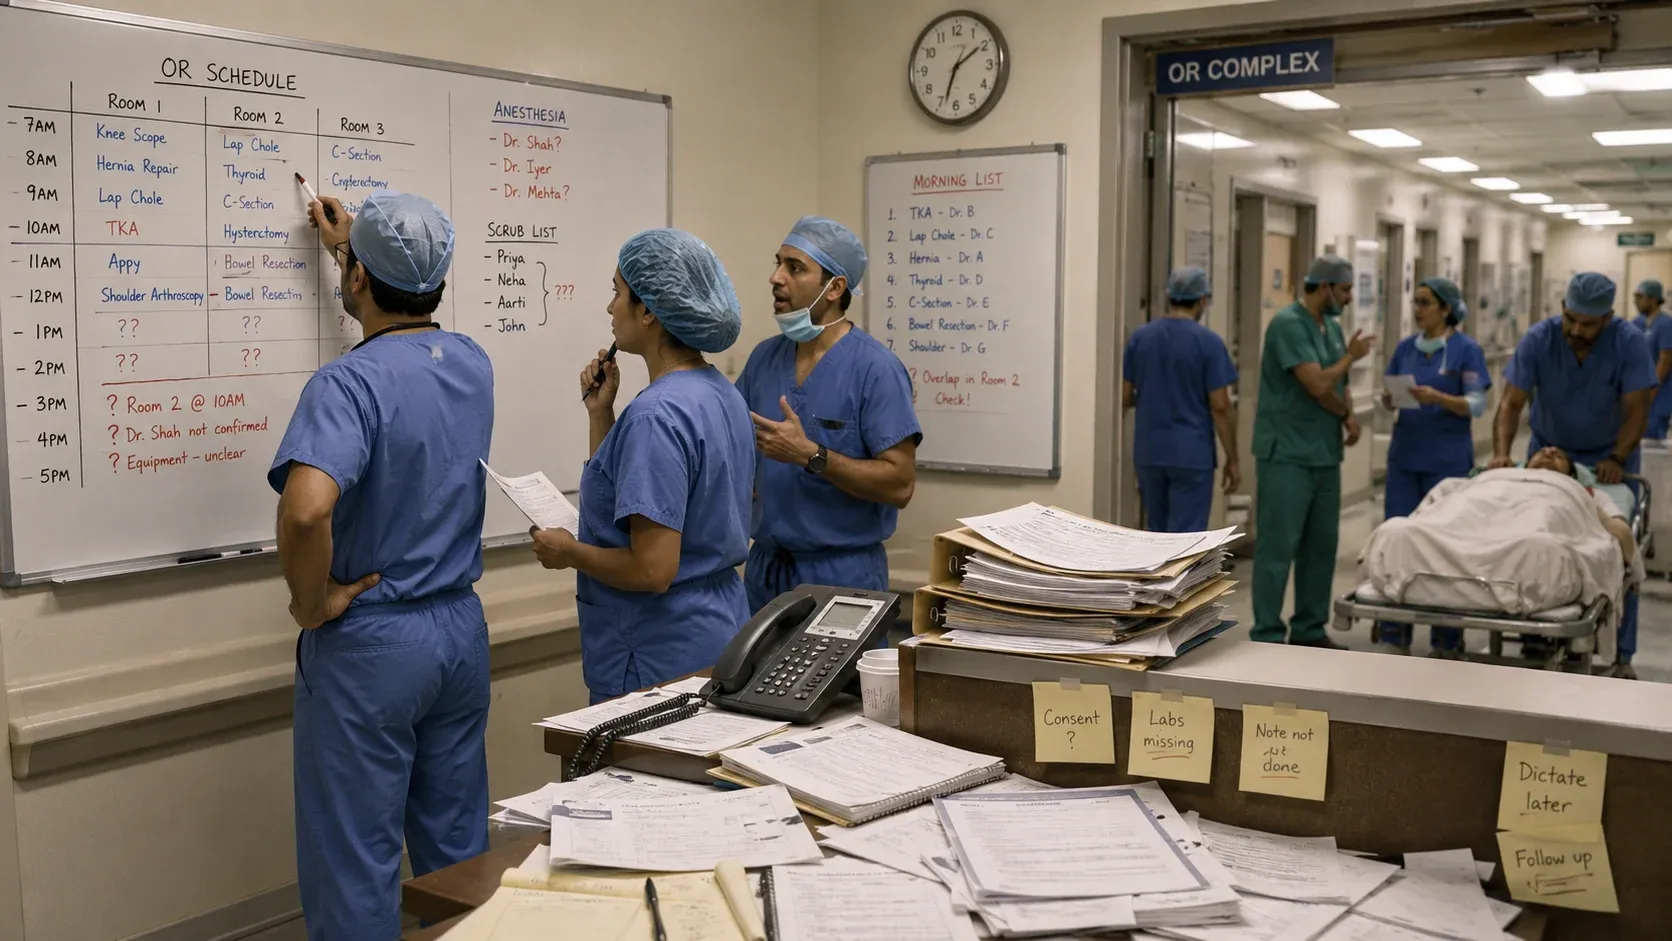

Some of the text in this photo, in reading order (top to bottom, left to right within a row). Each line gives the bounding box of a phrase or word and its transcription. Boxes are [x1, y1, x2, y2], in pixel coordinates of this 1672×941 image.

[937, 31, 945, 43] 11
[951, 24, 963, 36] 12
[971, 28, 976, 39] 1
[925, 47, 936, 58] 10
[981, 40, 989, 52] 2
[921, 65, 928, 77] 9
[986, 59, 993, 70] 3
[1168, 51, 1320, 83] OR COMPLEX
[161, 57, 297, 91] OR SCHEDULE
[925, 83, 933, 94] 8
[980, 78, 987, 90] 4
[157, 100, 161, 113] 1
[937, 95, 944, 108] 7
[952, 100, 960, 111] 6
[968, 93, 976, 105] 5
[274, 112, 284, 125] 2
[493, 100, 567, 125] ANESTHESIA
[24, 116, 56, 134] 7AM
[377, 123, 385, 135] 3
[96, 122, 167, 148] Knee Scope
[503, 132, 520, 149] Dr.
[223, 135, 280, 154] Lap Chole
[332, 144, 382, 161] C-Section
[26, 150, 57, 166] 8AM
[97, 155, 179, 178] Hernia Repair
[223, 164, 266, 184] Thyroid
[503, 157, 552, 179] Dr. Iyer
[913, 172, 1004, 190] MORNING LIST
[27, 184, 58, 201] 9AM
[99, 188, 164, 209] Lap Chole
[504, 182, 521, 199] Dr.
[223, 194, 274, 210] C-Section
[887, 208, 897, 221] 1.
[910, 207, 932, 220] TKA
[949, 207, 963, 218] Dr.
[967, 205, 975, 218] B
[27, 220, 61, 235] 10AM
[105, 220, 140, 236] TKA
[488, 221, 558, 239] SCRUB LIST
[887, 230, 897, 242] 2.
[909, 230, 927, 244] Lap
[971, 228, 985, 240] Dr.
[986, 227, 995, 239] C
[29, 254, 61, 269] 11AM
[108, 253, 141, 274] Appy
[262, 254, 307, 270] Resection
[497, 248, 526, 270] Priya
[887, 253, 897, 265] 3.
[909, 251, 941, 264] Hernia
[959, 252, 972, 264] Dr.
[976, 251, 984, 263] A
[498, 272, 526, 287] Neha
[887, 275, 897, 287] 4.
[909, 274, 943, 290] Thyroid
[959, 274, 972, 285] Dr.
[976, 274, 983, 285] D
[30, 289, 63, 303] 12PM
[101, 287, 205, 306] Shoulder Arthroscopy
[225, 286, 255, 301] Bowel
[497, 296, 526, 310] Aarti
[887, 297, 896, 309] 5.
[909, 297, 952, 309] C-Section
[966, 297, 979, 308] Dr.
[983, 297, 990, 308] E
[36, 324, 63, 339] 1PM
[497, 318, 526, 333] John
[886, 318, 896, 330] 6.
[909, 318, 934, 330] Bowel
[939, 318, 976, 331] Resection
[988, 319, 1001, 331] Dr.
[1003, 319, 1009, 331] F
[909, 339, 946, 353] Shoulder
[961, 342, 974, 353] Dr.
[977, 342, 986, 354] G
[35, 360, 66, 375] 2PM
[923, 370, 960, 389] Overlap
[966, 373, 975, 384] in
[981, 370, 1007, 386] Room
[1012, 374, 1020, 387] 2
[36, 396, 67, 411] 3PM
[106, 393, 246, 416] ? Room 2 @ 10AM
[935, 391, 971, 407] Check!
[107, 415, 268, 445] ? Dr. Shah not confirmed
[37, 432, 68, 447] 4PM
[108, 452, 120, 473] ?
[127, 450, 188, 474] Equipment
[204, 446, 247, 462] unclear
[40, 468, 70, 483] 5PM
[1043, 708, 1101, 726] Consent
[1149, 709, 1185, 727] Labs
[1066, 731, 1076, 749] ?
[1255, 723, 1314, 741] Note not
[1143, 736, 1195, 754] missing
[1263, 757, 1301, 773] done
[1519, 761, 1588, 787] Dictate
[1526, 791, 1573, 813] later
[1515, 848, 1593, 871] Follow up
